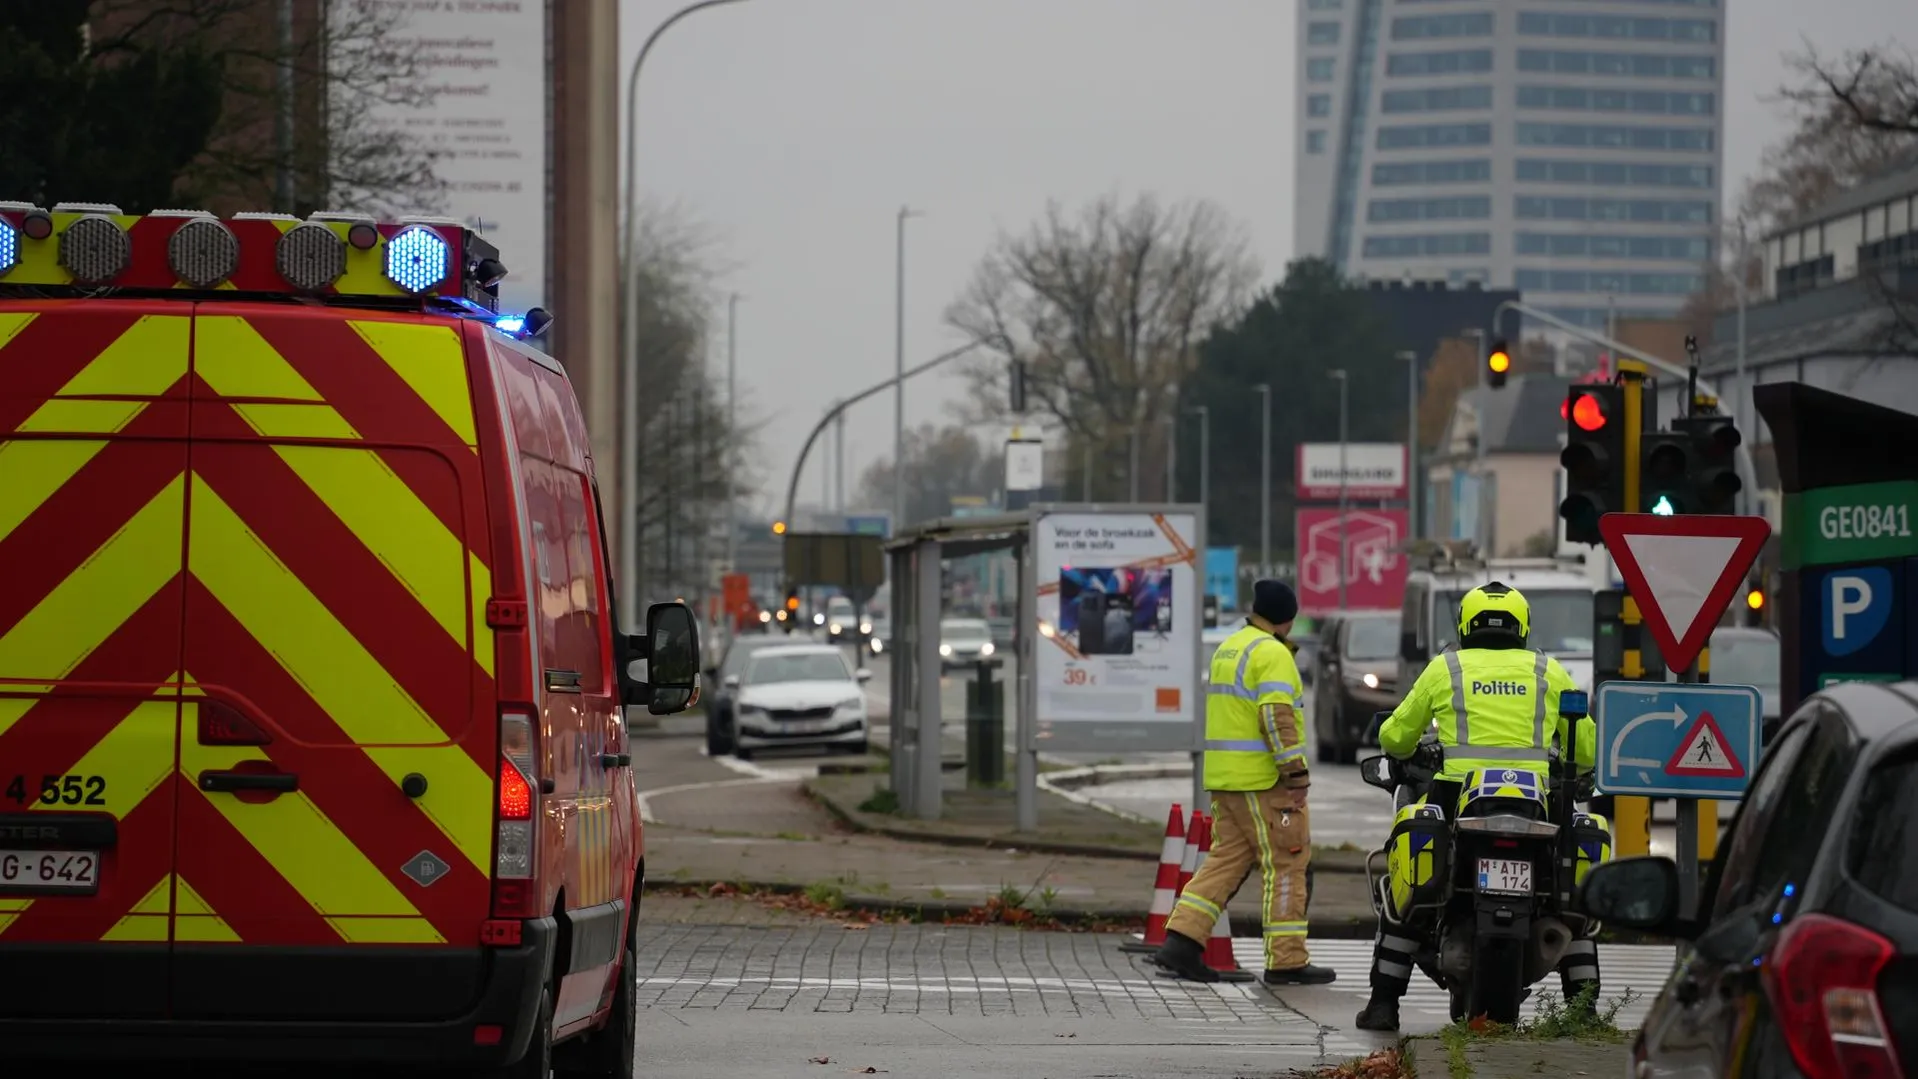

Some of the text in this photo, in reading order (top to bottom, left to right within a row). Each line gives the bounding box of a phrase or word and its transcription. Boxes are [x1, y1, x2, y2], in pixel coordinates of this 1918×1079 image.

[1820, 504, 1911, 539] GE0841
[1055, 527, 1155, 538] Voor de broekzak
[1055, 539, 1115, 550] en de sofa
[1832, 576, 1873, 639] P
[1063, 668, 1087, 685] 39
[1472, 681, 1527, 696] Politie
[5, 775, 106, 805] 4 552
[2, 854, 93, 881] G-642
[1500, 861, 1529, 876] ATP
[1502, 876, 1529, 890] 174
